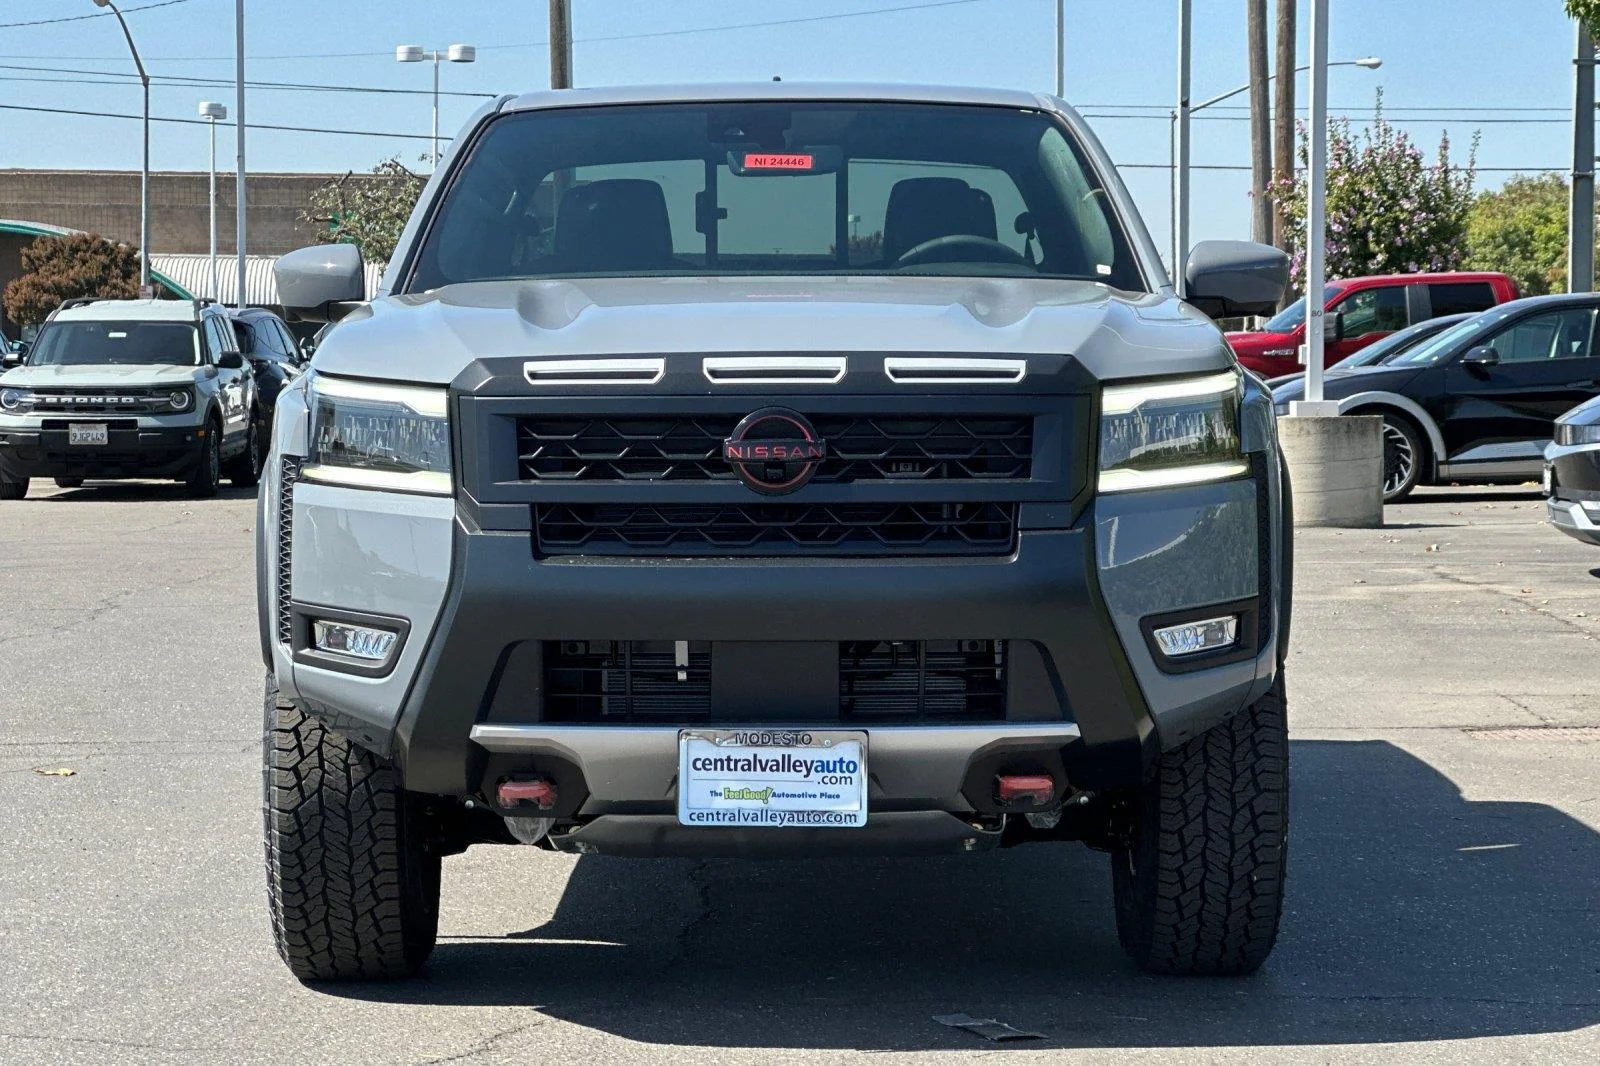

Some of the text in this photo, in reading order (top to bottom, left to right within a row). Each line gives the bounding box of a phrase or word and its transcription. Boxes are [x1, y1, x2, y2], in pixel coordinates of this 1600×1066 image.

[754, 157, 805, 166] NI 24446
[728, 446, 823, 458] NISSAN
[735, 732, 812, 746] MODESTO
[692, 753, 858, 778] centralvalleyauto
[817, 774, 853, 786] .com
[710, 790, 722, 798] The
[771, 791, 817, 799] Automotive
[819, 792, 841, 800] Place
[689, 809, 858, 826] centralvalleyauto.com
